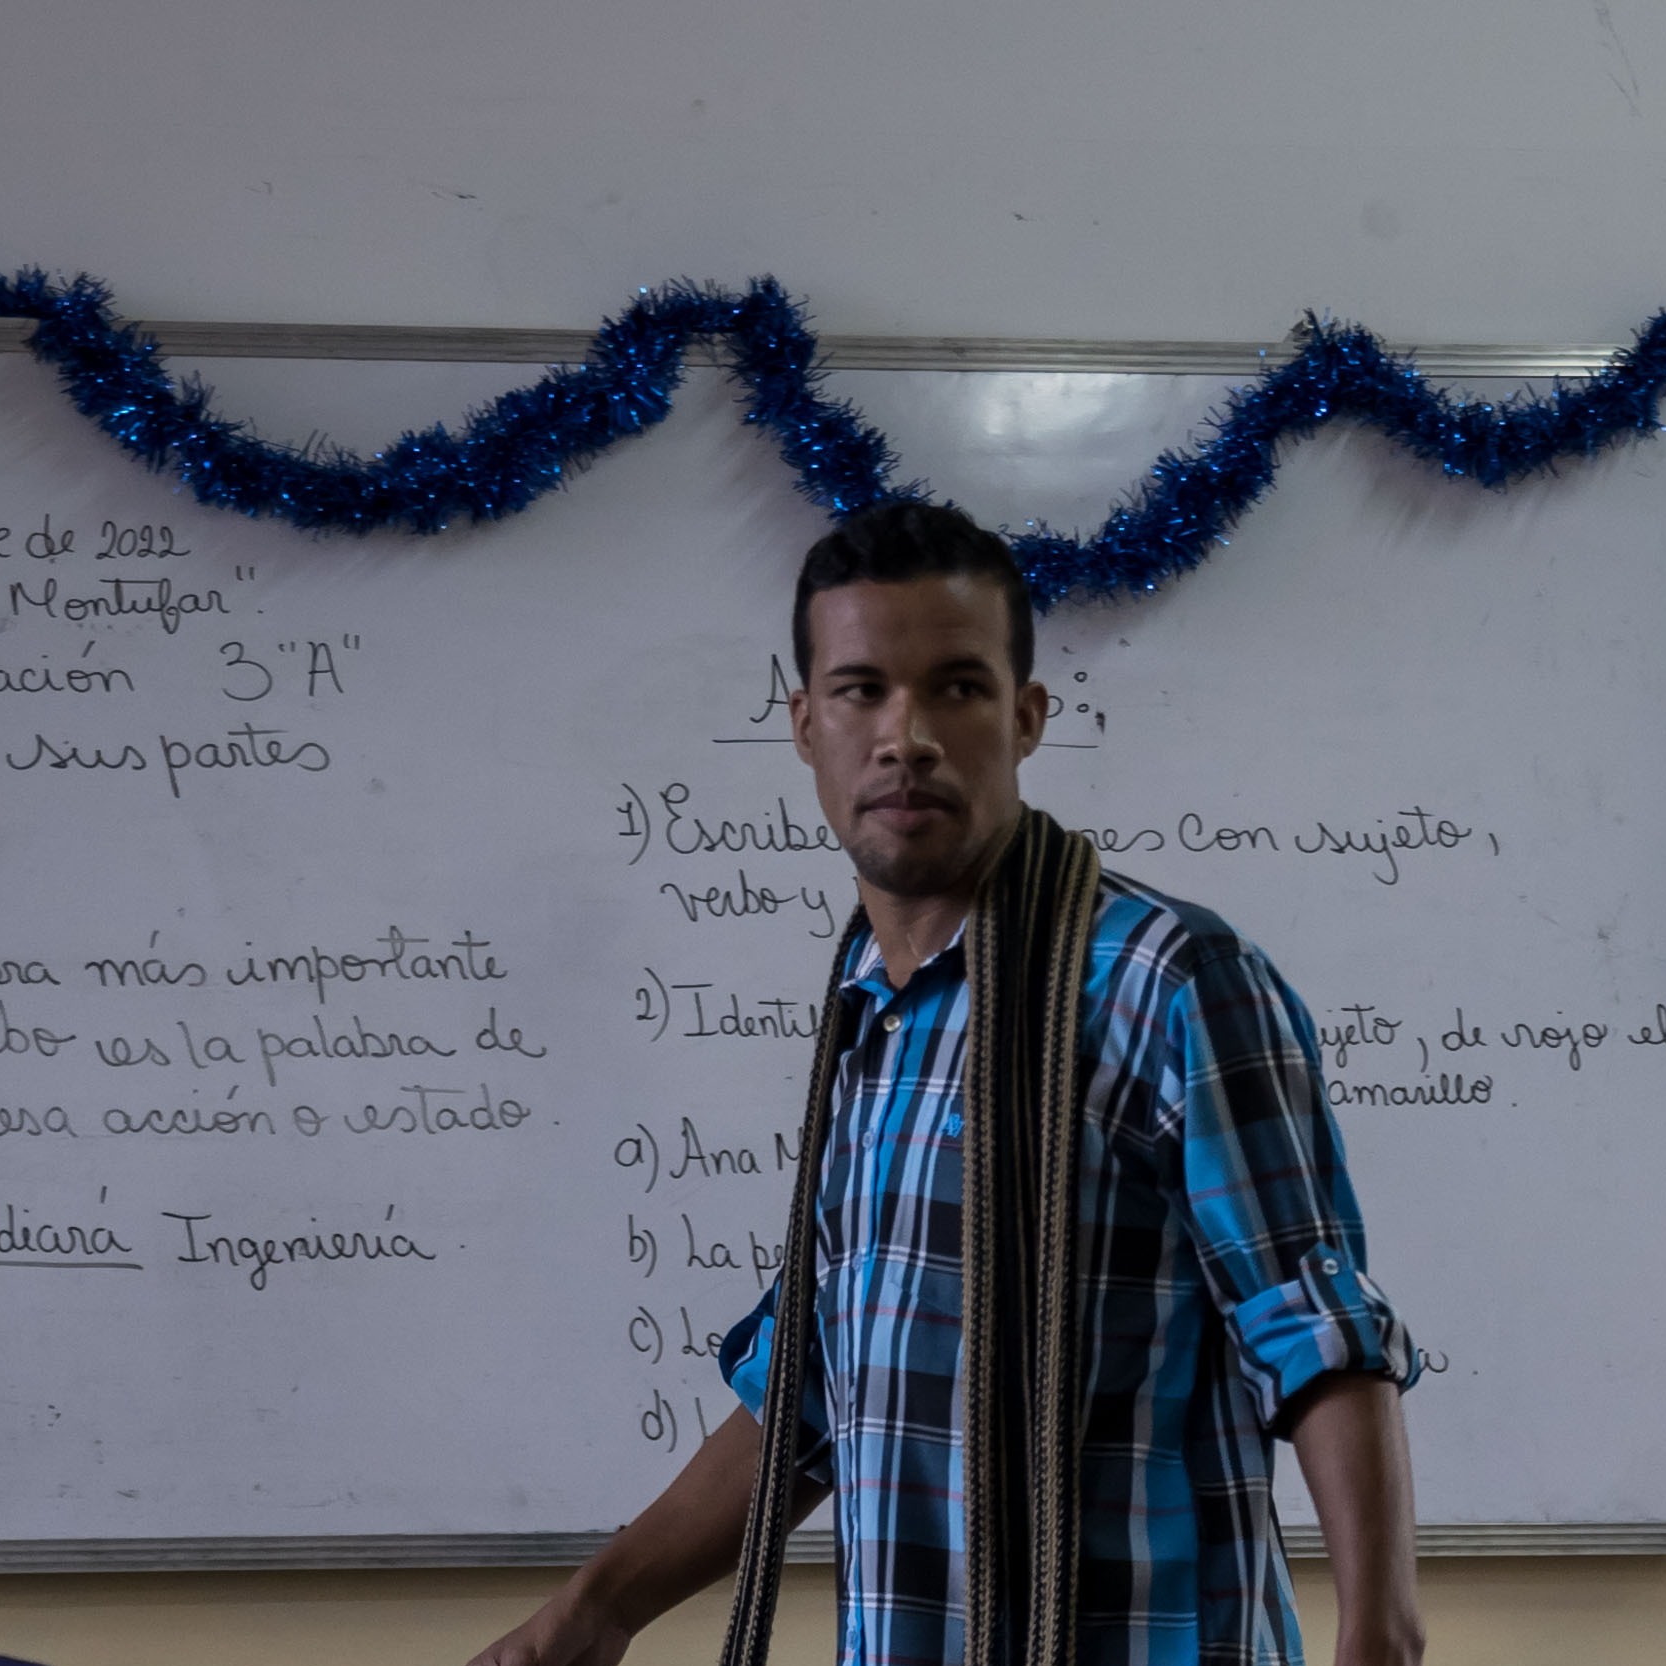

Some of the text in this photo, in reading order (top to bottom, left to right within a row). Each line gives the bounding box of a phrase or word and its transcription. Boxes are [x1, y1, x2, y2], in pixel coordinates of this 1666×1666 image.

[24, 513, 76, 561] de
[94, 519, 192, 560] 2022
[5, 732, 148, 774] sus
[159, 721, 333, 799] partes
[615, 781, 844, 867] 1) Escribe
[659, 868, 800, 923] verbo
[801, 885, 837, 939] y
[84, 929, 209, 989] más
[226, 925, 509, 1005] importante
[635, 967, 671, 1043] 2)
[1441, 1006, 1489, 1052] de
[1500, 1010, 1610, 1071] rojo
[93, 1036, 173, 1069] es
[176, 1020, 248, 1070] la
[256, 1015, 459, 1088] palabra
[474, 1006, 549, 1060] de
[101, 1084, 279, 1138] acción
[293, 1104, 330, 1139] o
[614, 1123, 659, 1194] a)
[668, 1115, 763, 1180] Ana
[628, 1213, 658, 1279] b)
[681, 1212, 742, 1270] La
[640, 1388, 678, 1454] d)
